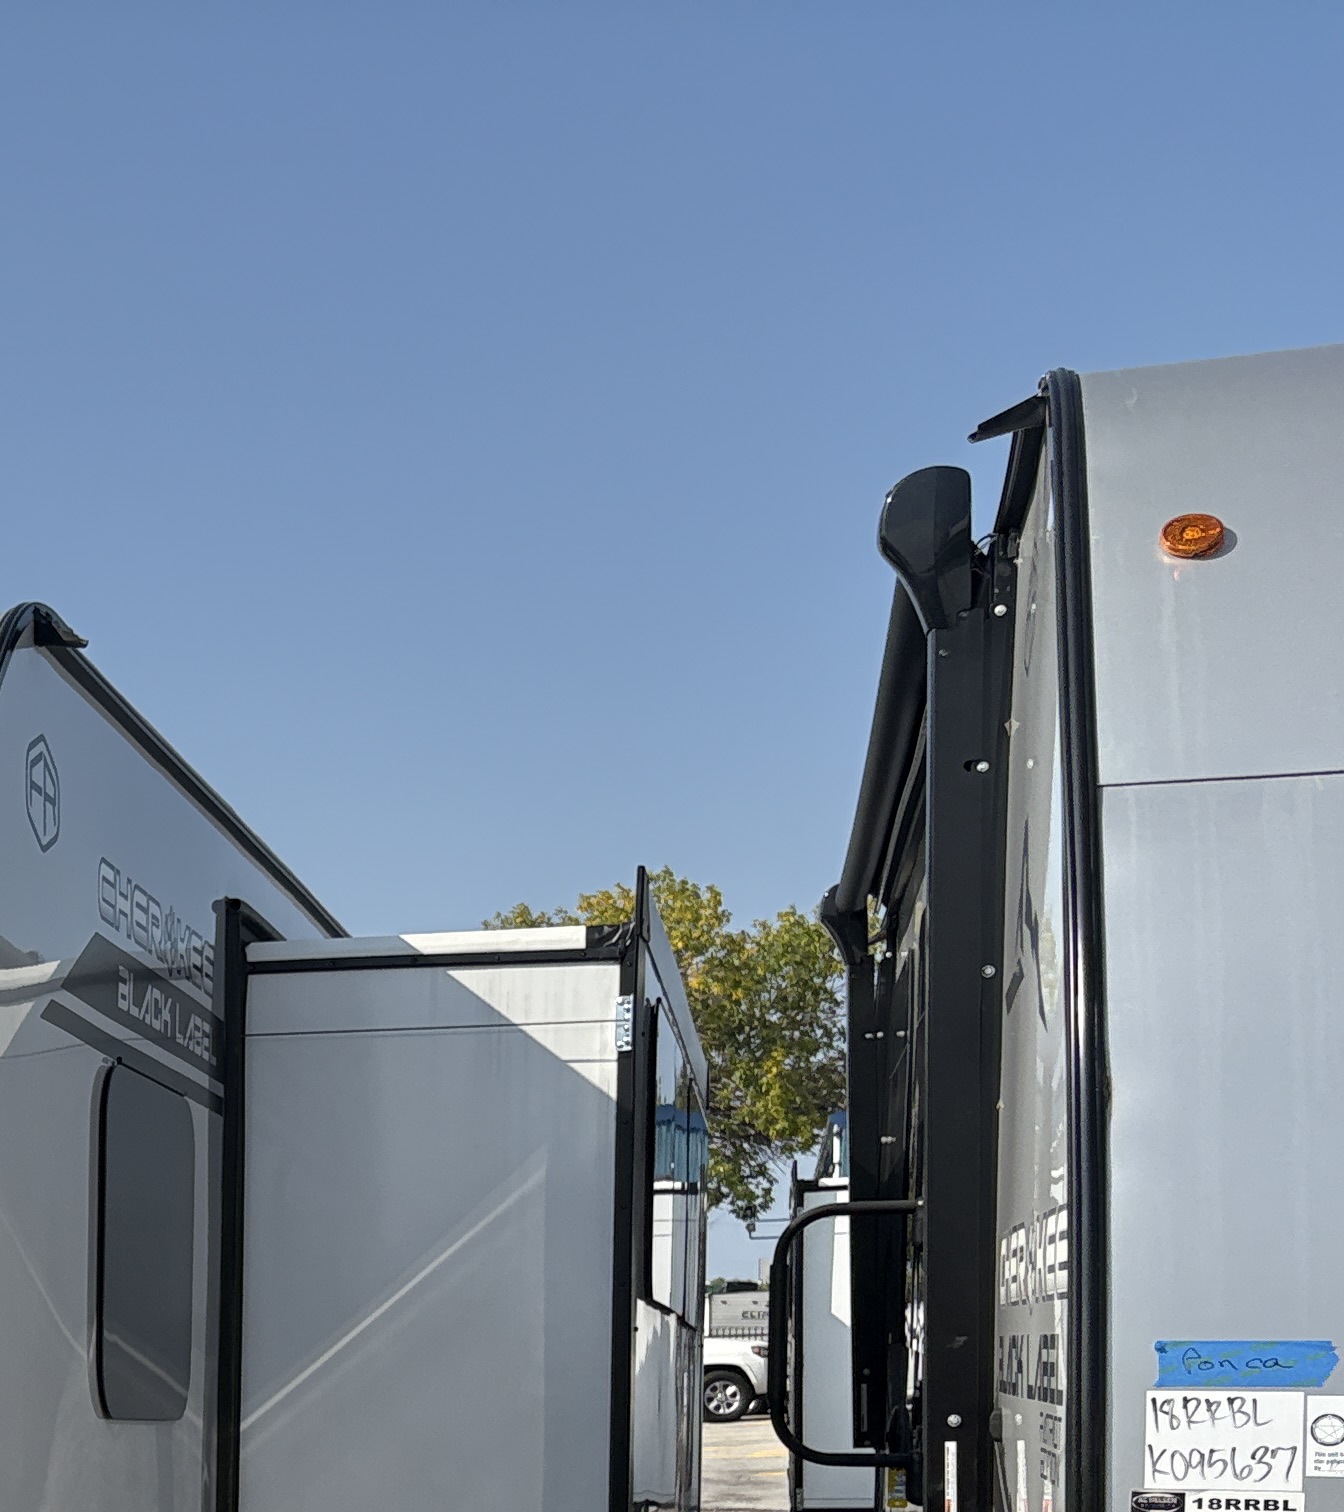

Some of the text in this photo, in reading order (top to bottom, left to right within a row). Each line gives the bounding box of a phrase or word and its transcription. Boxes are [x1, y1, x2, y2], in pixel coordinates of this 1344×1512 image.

[118, 965, 217, 1066] BLACK LABEL
[1181, 1347, 1295, 1375] Ponca
[1149, 1396, 1274, 1434] 18RRBL
[1147, 1443, 1299, 1483] K095637
[1191, 1497, 1298, 1512] 18RRBL
